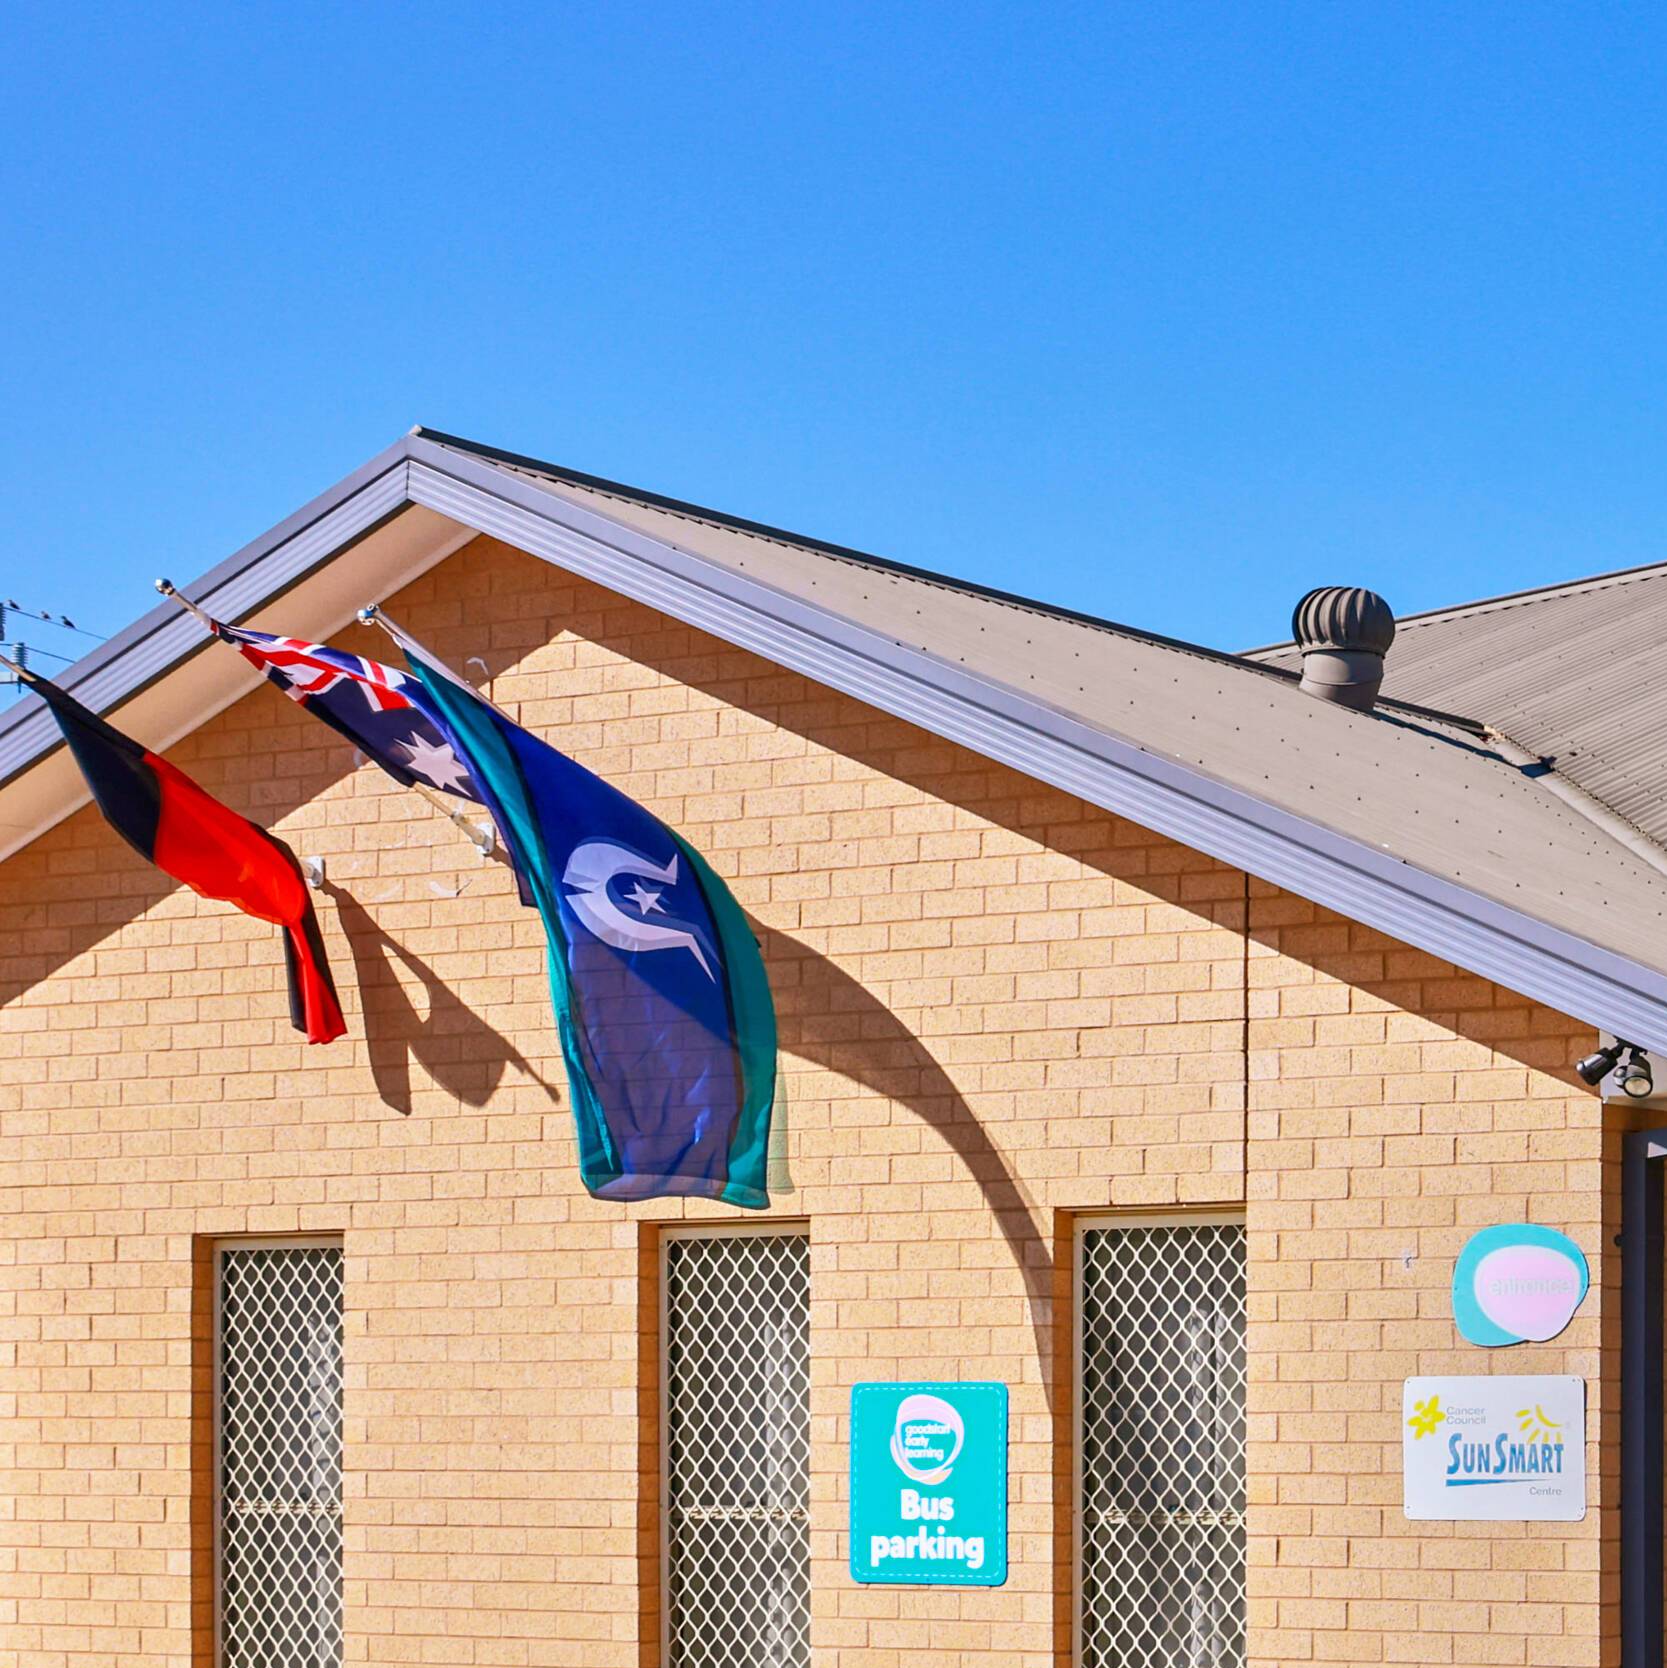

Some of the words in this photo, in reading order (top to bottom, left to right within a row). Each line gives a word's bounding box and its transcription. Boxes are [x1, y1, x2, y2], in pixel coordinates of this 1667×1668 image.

[1446, 1406, 1486, 1416] Cancer
[1446, 1415, 1487, 1425] Council
[904, 1423, 952, 1439] goodstart
[904, 1447, 945, 1462] learning
[1529, 1486, 1563, 1496] Centre
[900, 1488, 955, 1521] Bus
[870, 1525, 985, 1570] parking
